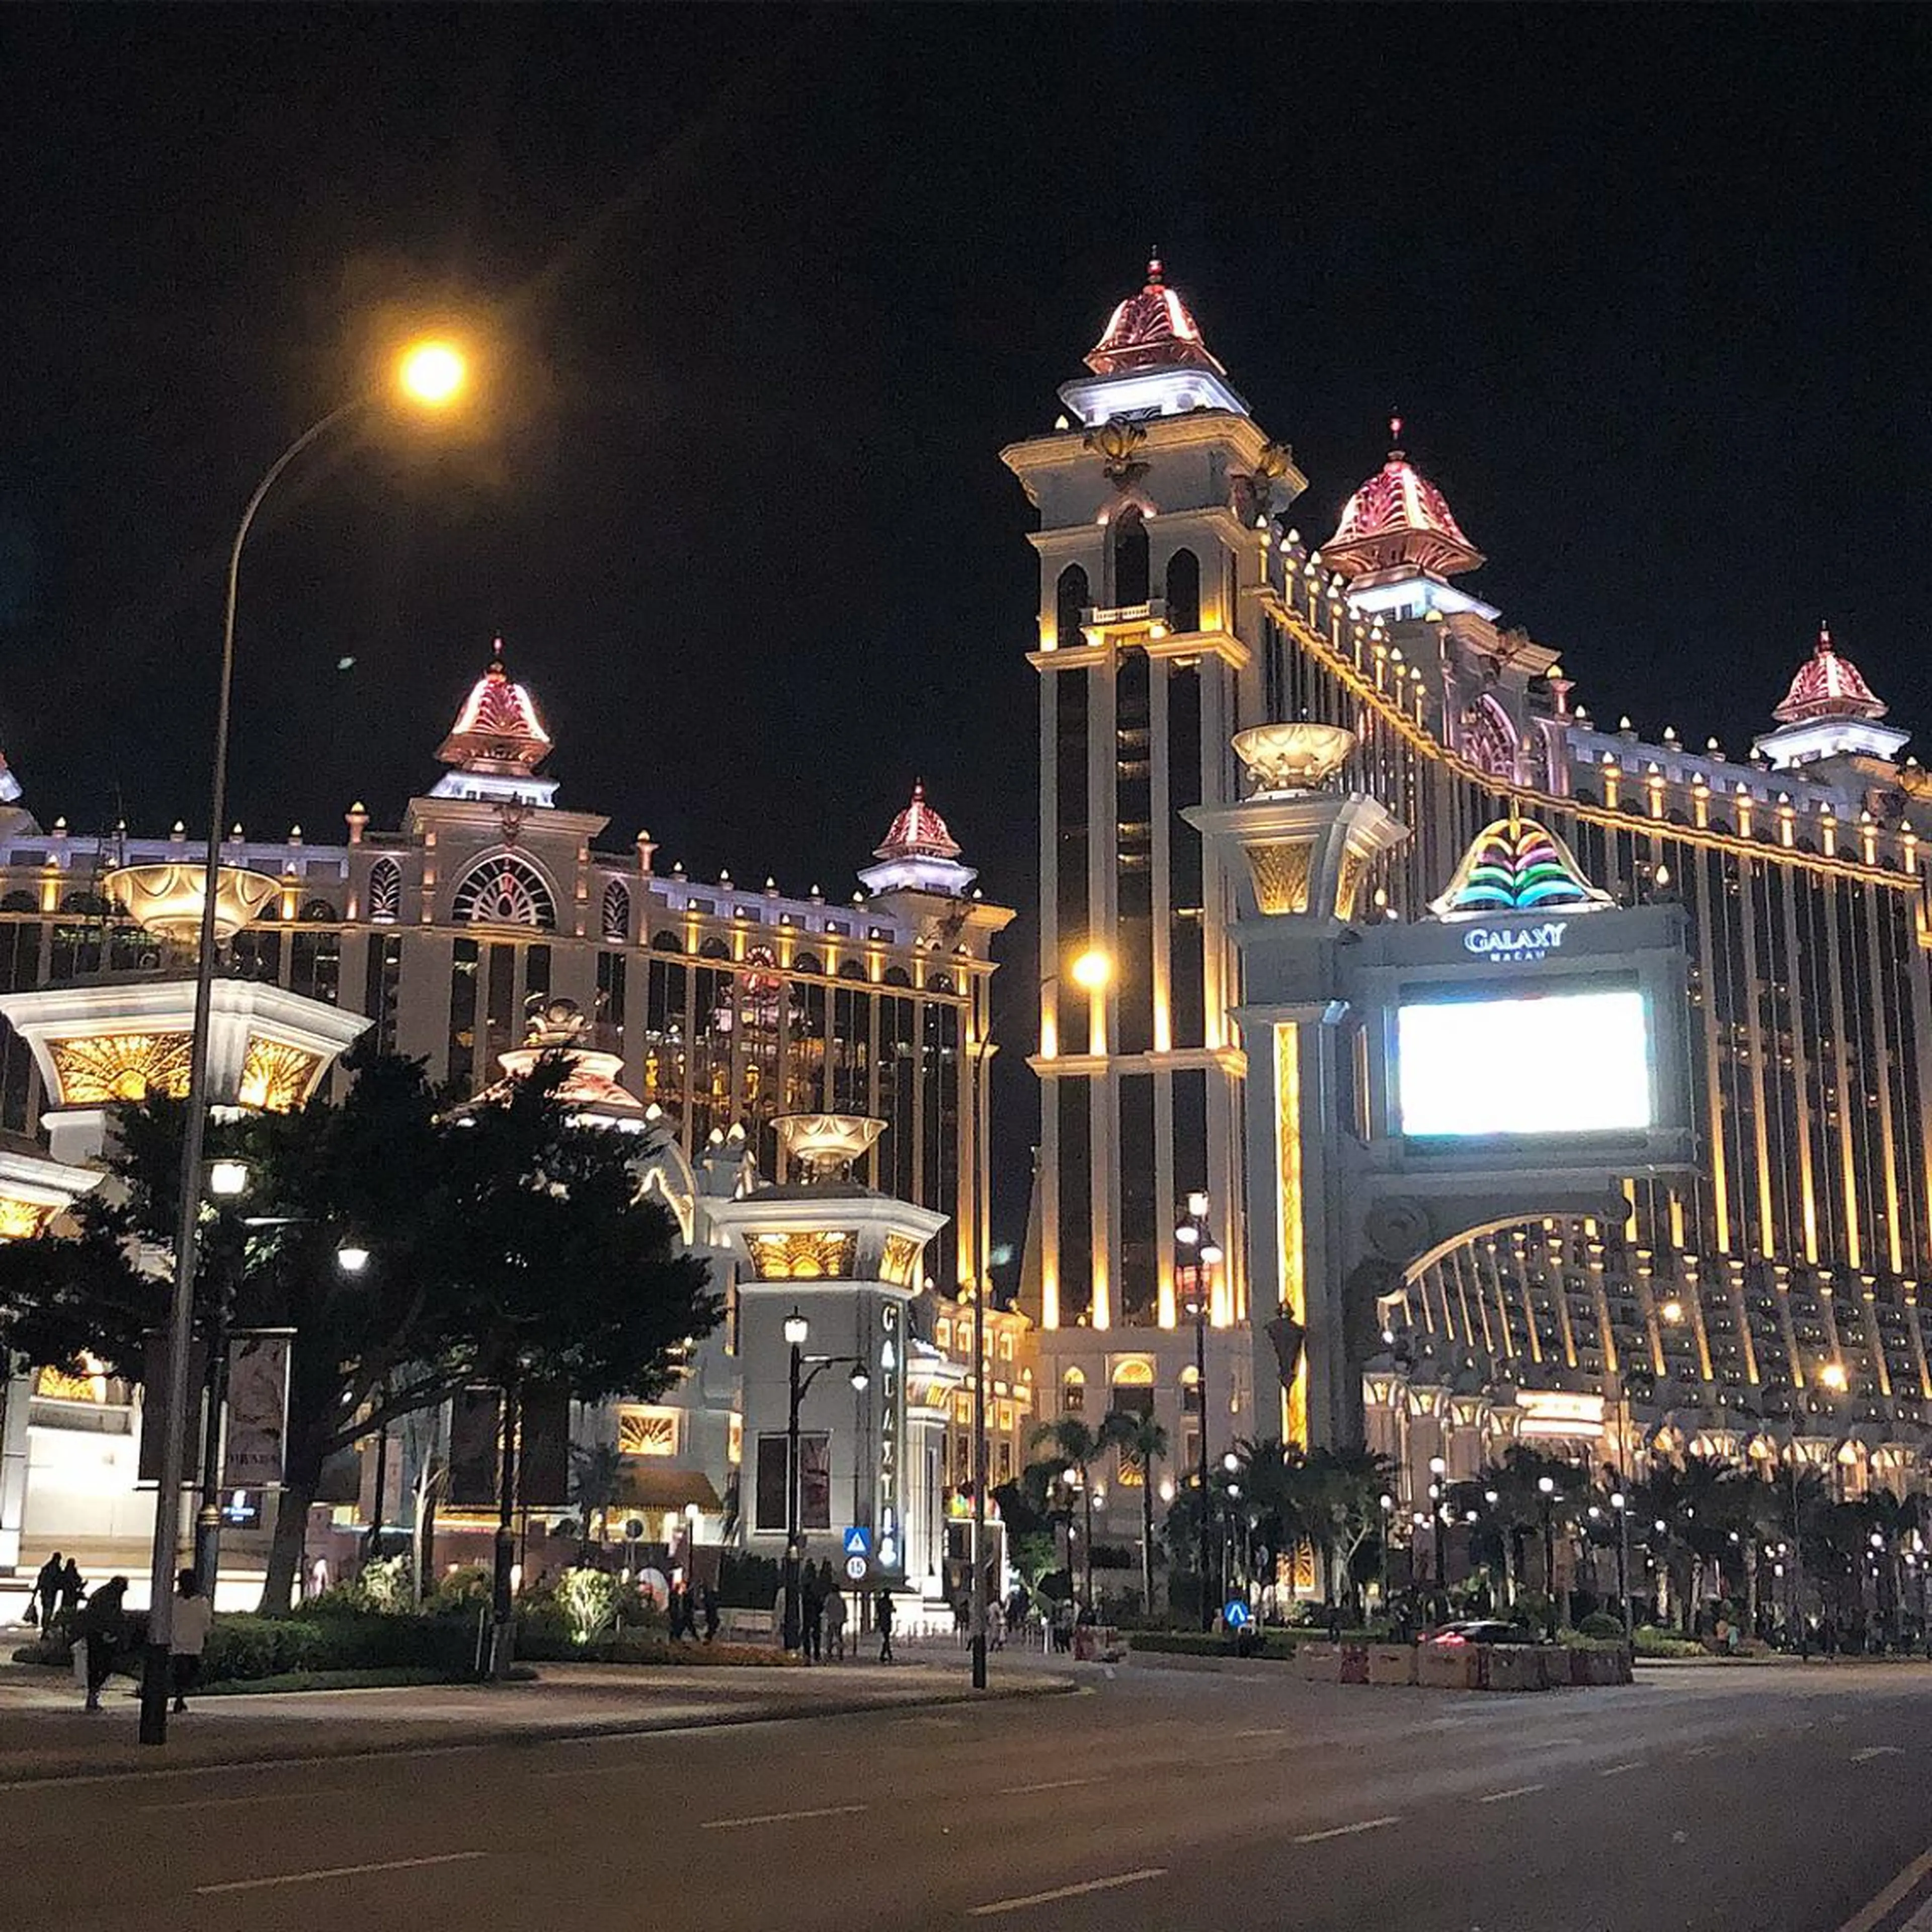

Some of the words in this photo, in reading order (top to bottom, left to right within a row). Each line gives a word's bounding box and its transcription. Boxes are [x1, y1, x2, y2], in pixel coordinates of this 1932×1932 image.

[1464, 922, 1568, 953] GALAXY
[1490, 950, 1545, 962] MACAU
[850, 1561, 863, 1574] 15
